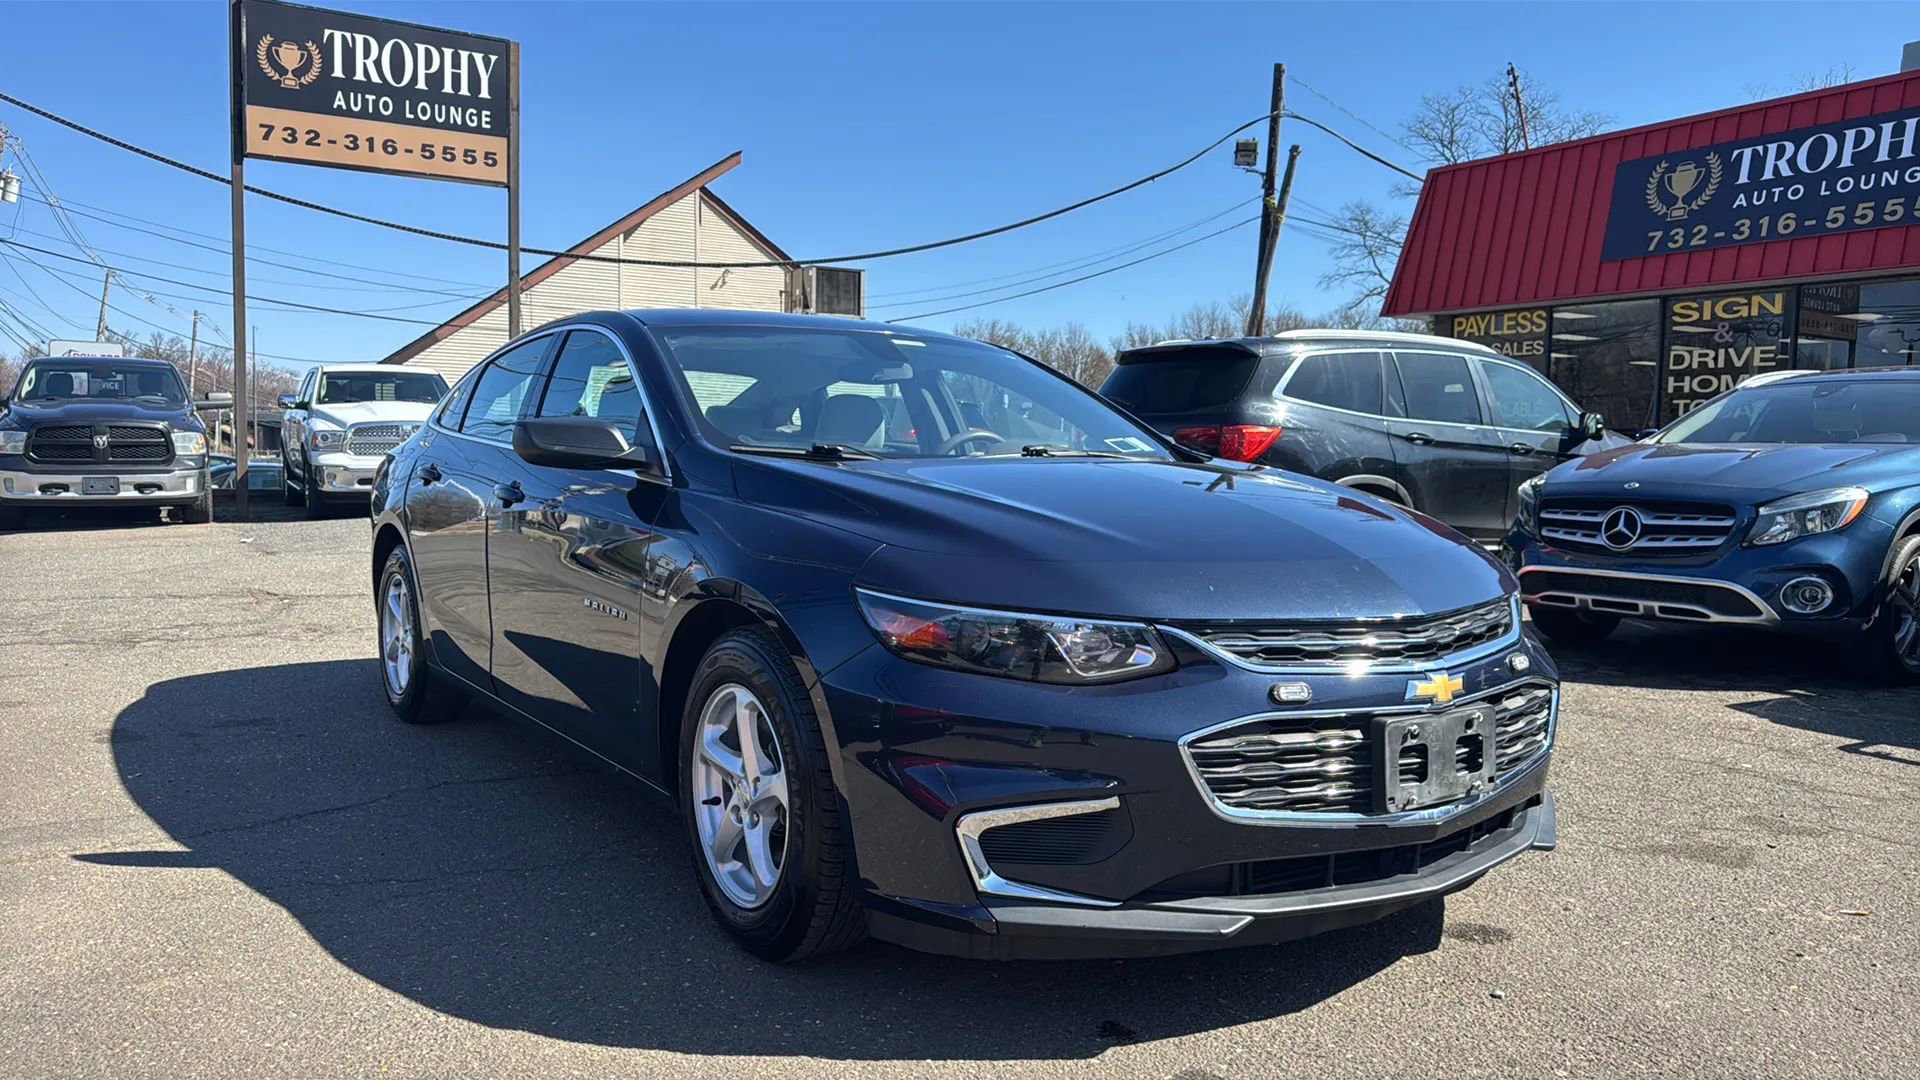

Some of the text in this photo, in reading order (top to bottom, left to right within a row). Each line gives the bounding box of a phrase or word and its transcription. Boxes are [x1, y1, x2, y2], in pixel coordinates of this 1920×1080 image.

[323, 28, 498, 99] TROPHY
[333, 90, 492, 129] AUTO LOUNGE
[258, 123, 499, 168] 732-316-5555
[1730, 116, 1920, 185] TROPH
[1732, 184, 1805, 209] AUTO
[1671, 292, 1784, 323] SIGN
[1453, 310, 1547, 338] PAYLESS
[1714, 322, 1733, 343] &
[1491, 340, 1545, 356] SALES
